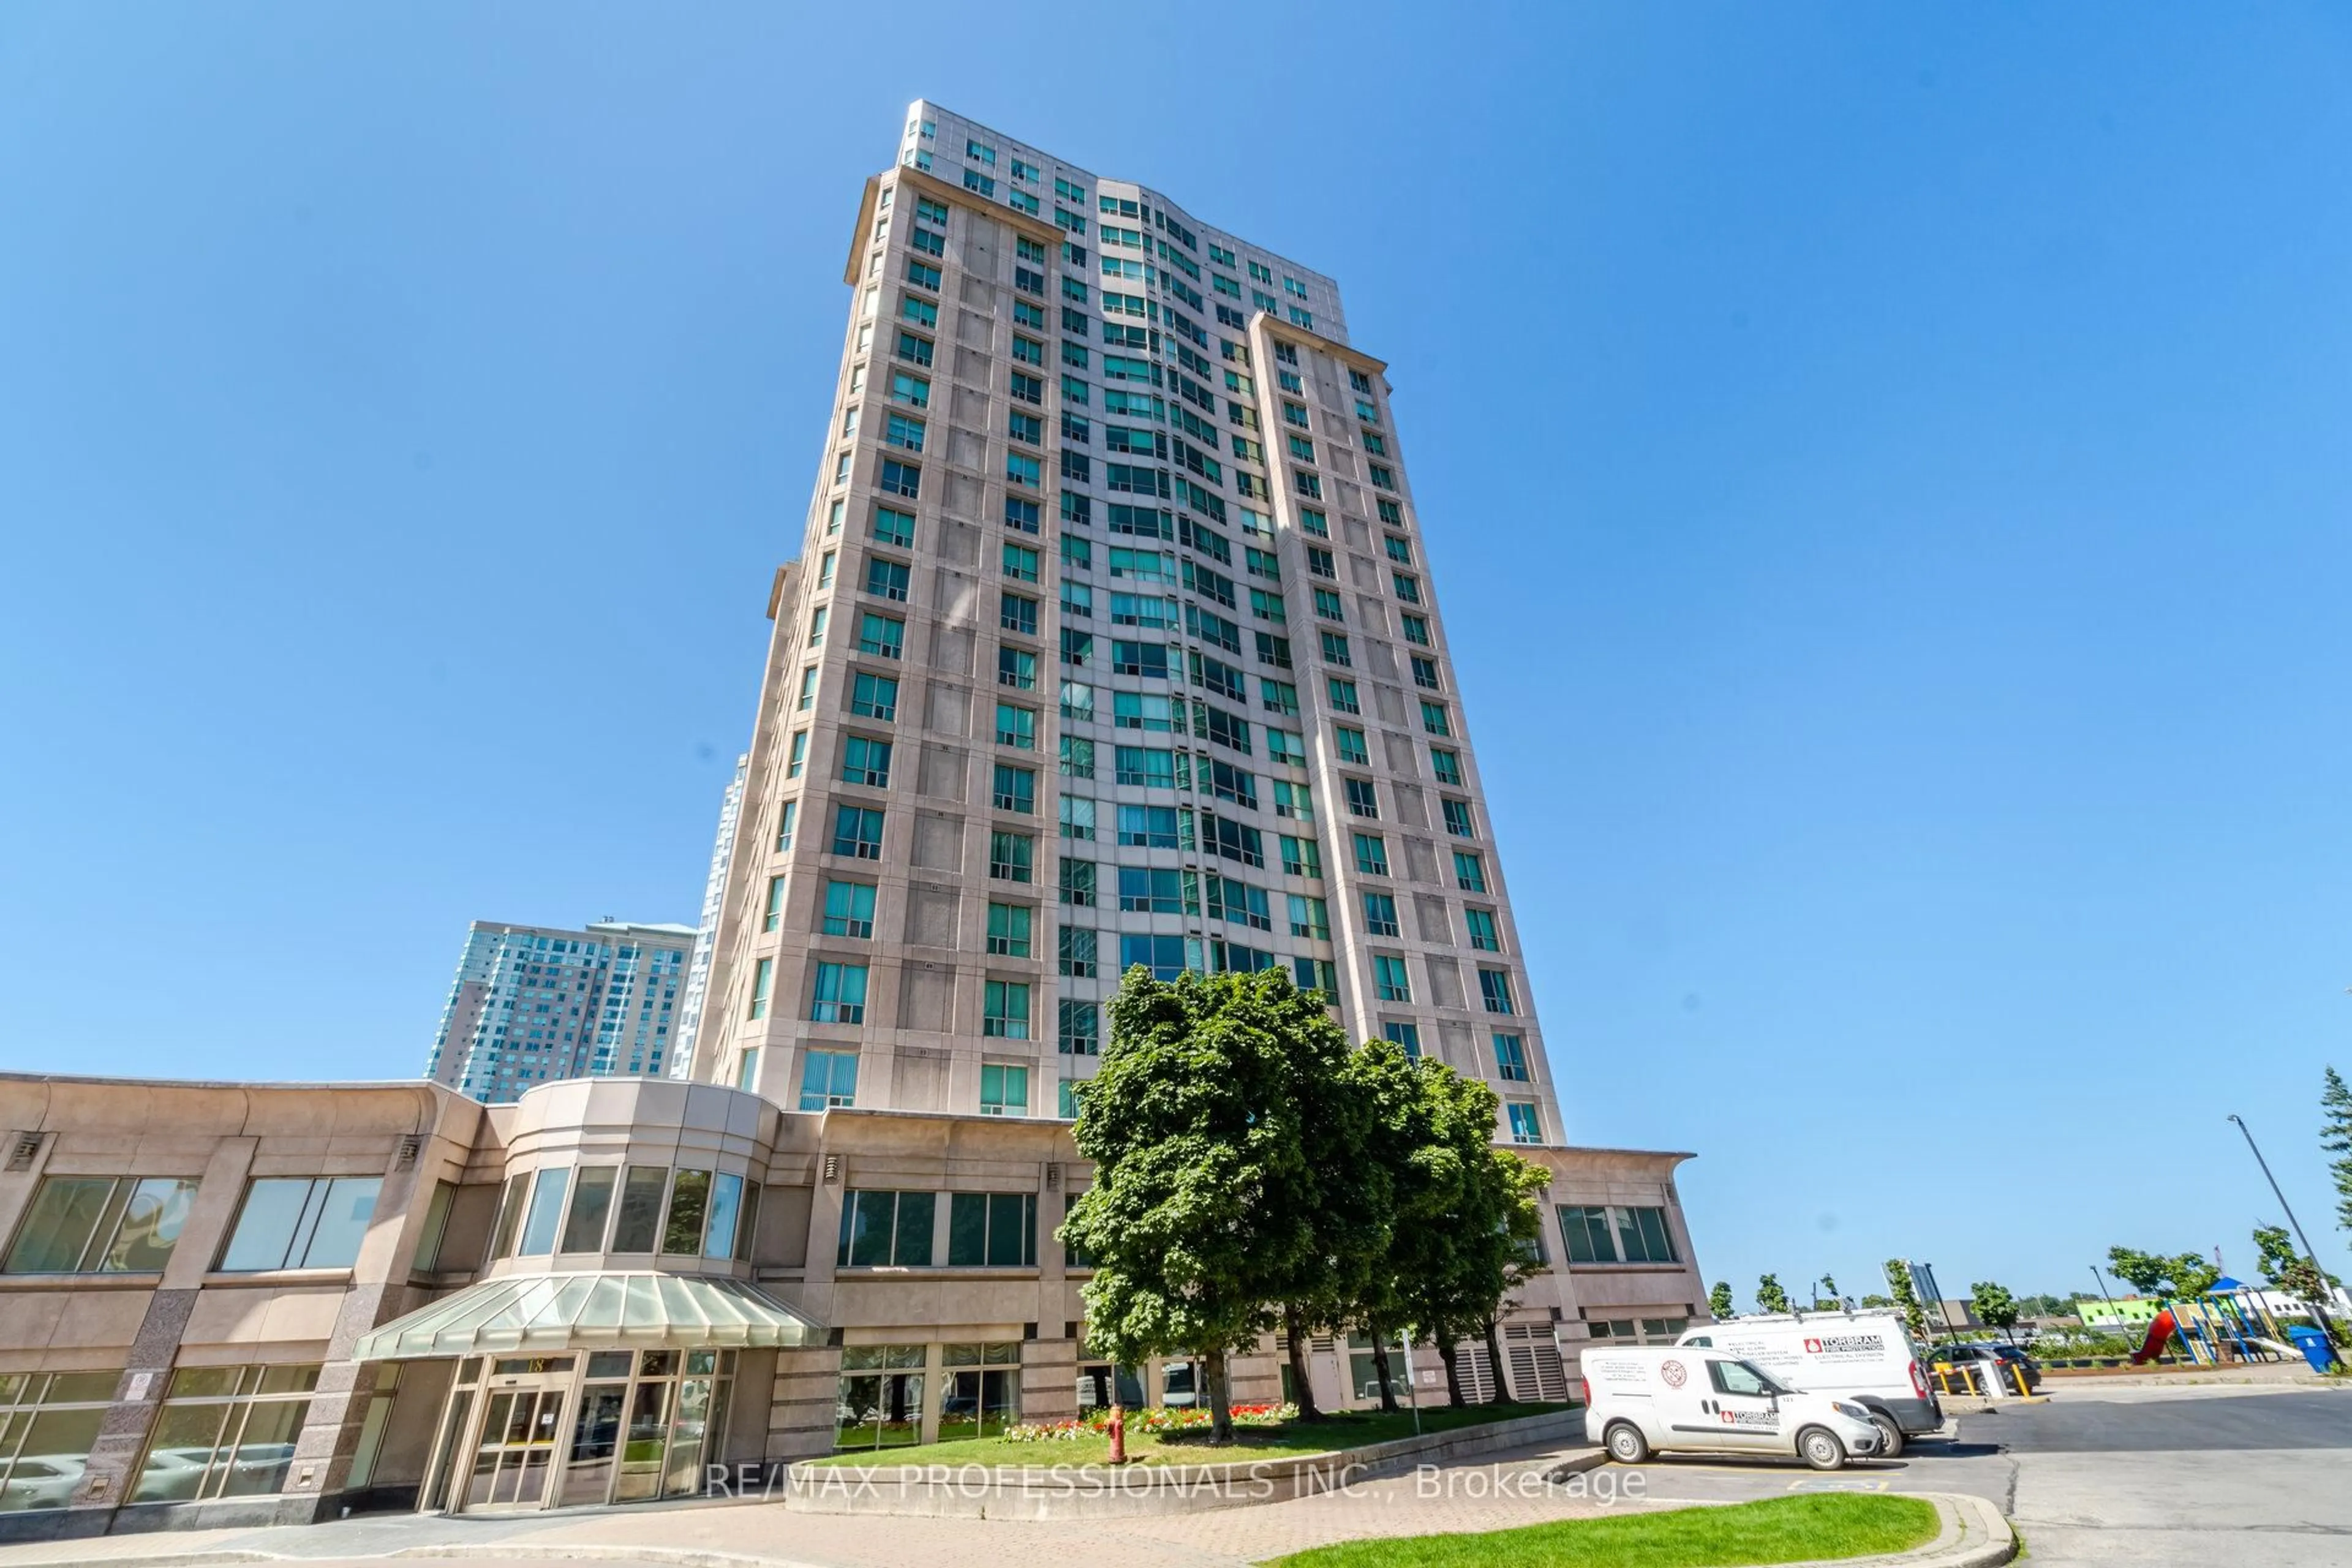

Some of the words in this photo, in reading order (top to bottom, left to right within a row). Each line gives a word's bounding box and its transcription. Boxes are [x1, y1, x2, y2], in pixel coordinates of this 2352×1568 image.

[1823, 1335, 1882, 1346] TORBRAM
[528, 1359, 544, 1373] 18
[1734, 1411, 1779, 1420] TORBRAM
